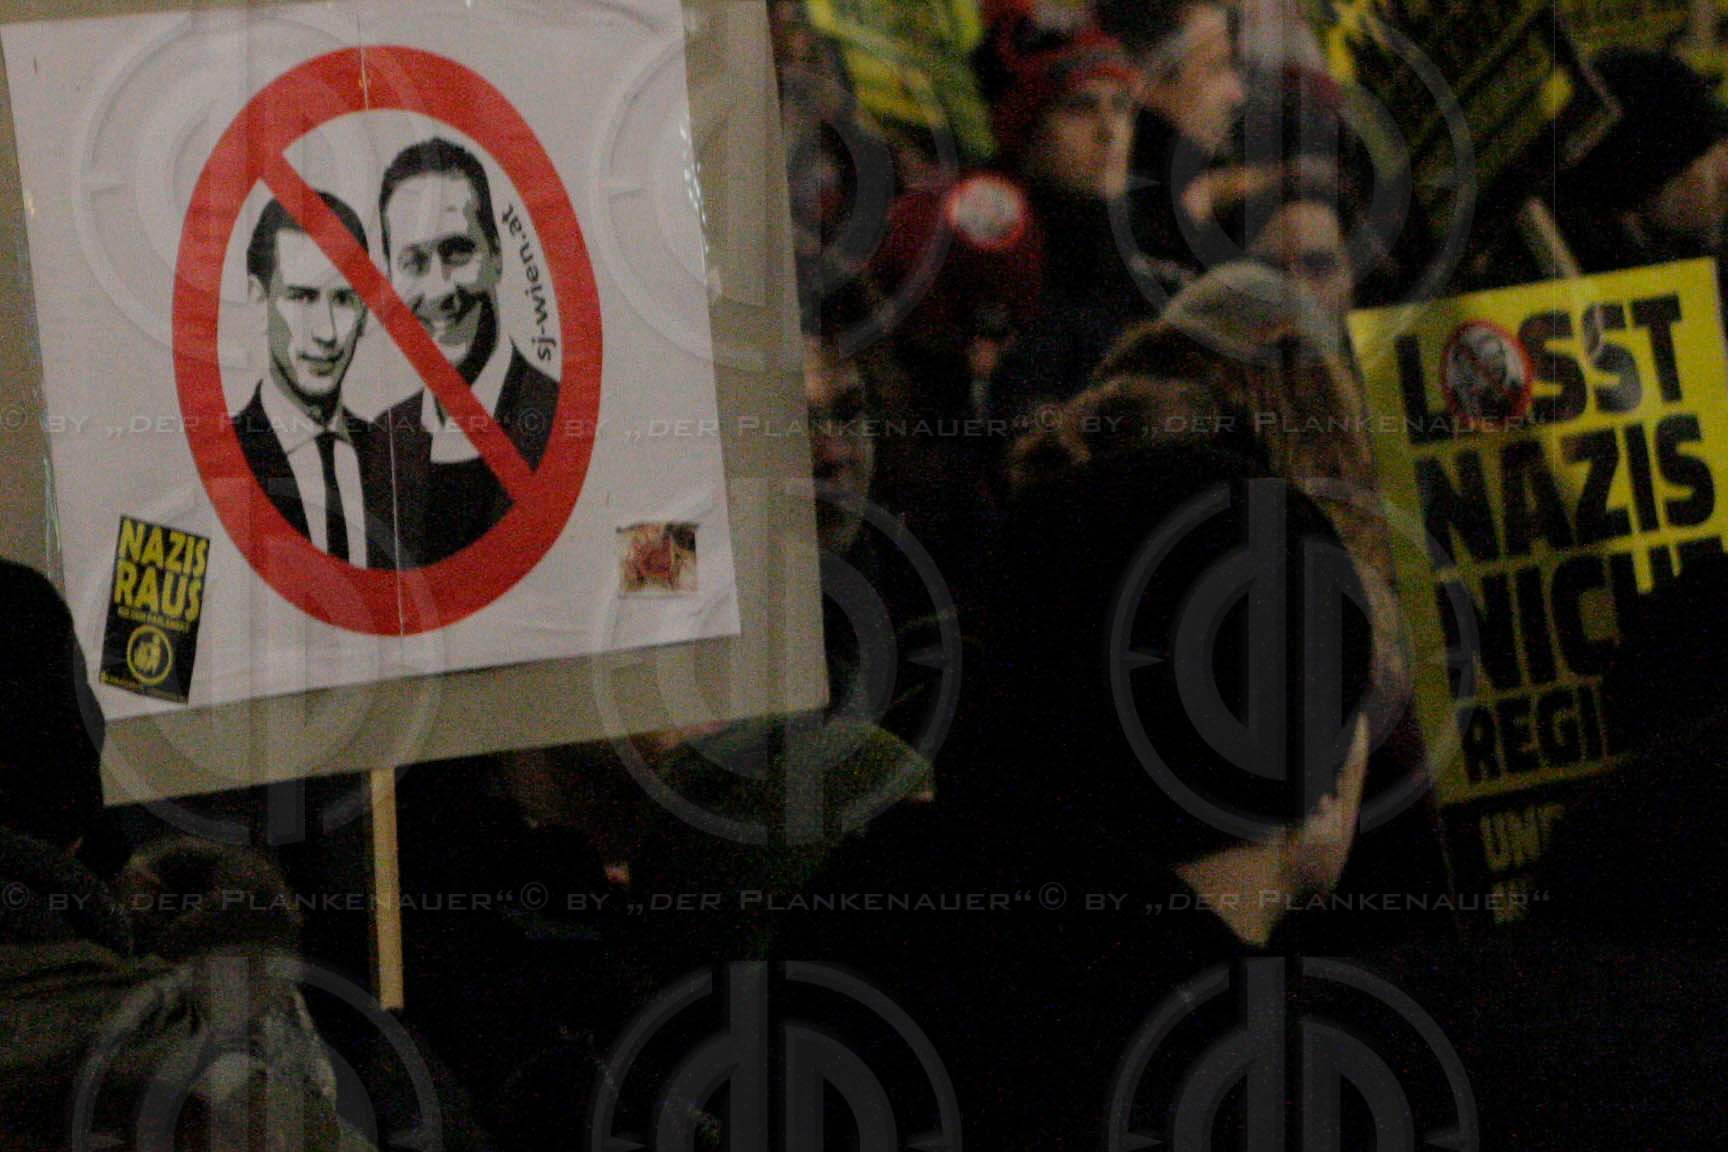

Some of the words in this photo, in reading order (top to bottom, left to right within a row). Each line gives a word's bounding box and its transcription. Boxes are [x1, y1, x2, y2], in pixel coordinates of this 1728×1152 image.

[501, 203, 557, 361] sj-wien.at
[1394, 292, 1684, 446] LSST
[119, 518, 208, 578] NAZIS
[1414, 415, 1716, 564] NAZIS
[113, 560, 202, 623] RAUS
[1458, 684, 1600, 782] REGI
